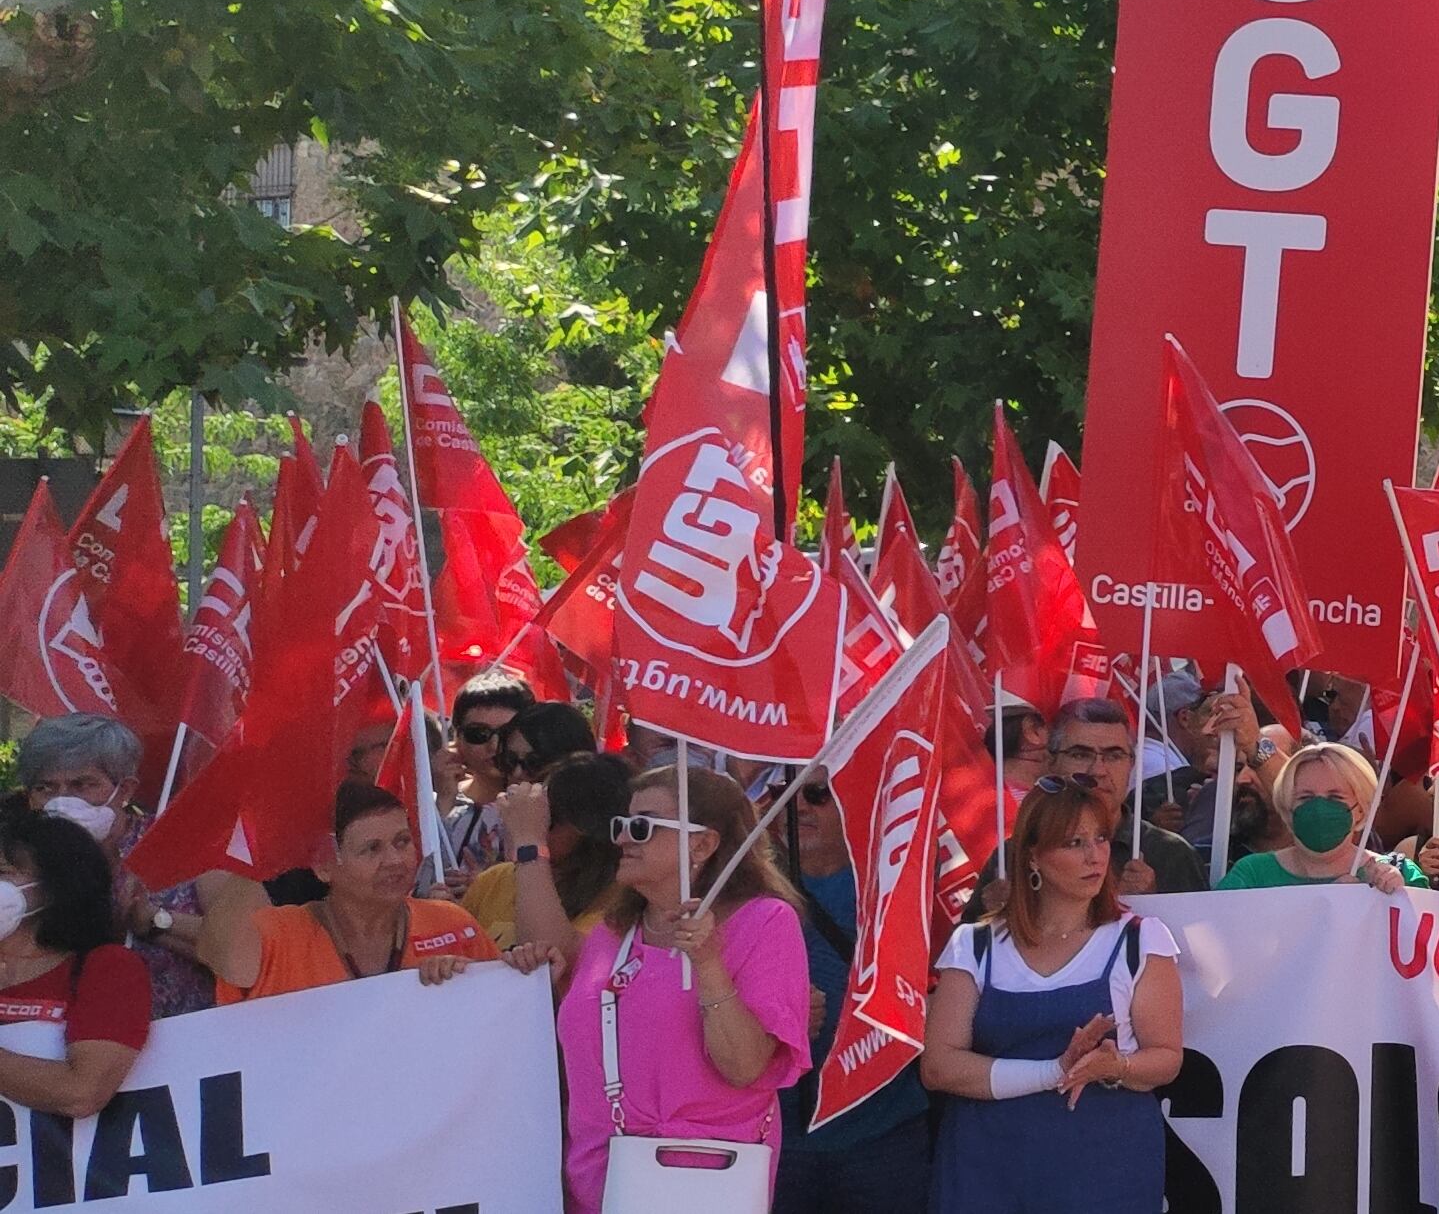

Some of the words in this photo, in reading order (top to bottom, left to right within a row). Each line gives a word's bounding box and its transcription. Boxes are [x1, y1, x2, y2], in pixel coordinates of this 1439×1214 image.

[634, 442, 760, 628] UGT
[1091, 573, 1215, 613] Castilla-
[618, 658, 790, 727] www.ugt.
[414, 932, 457, 951] CCOO
